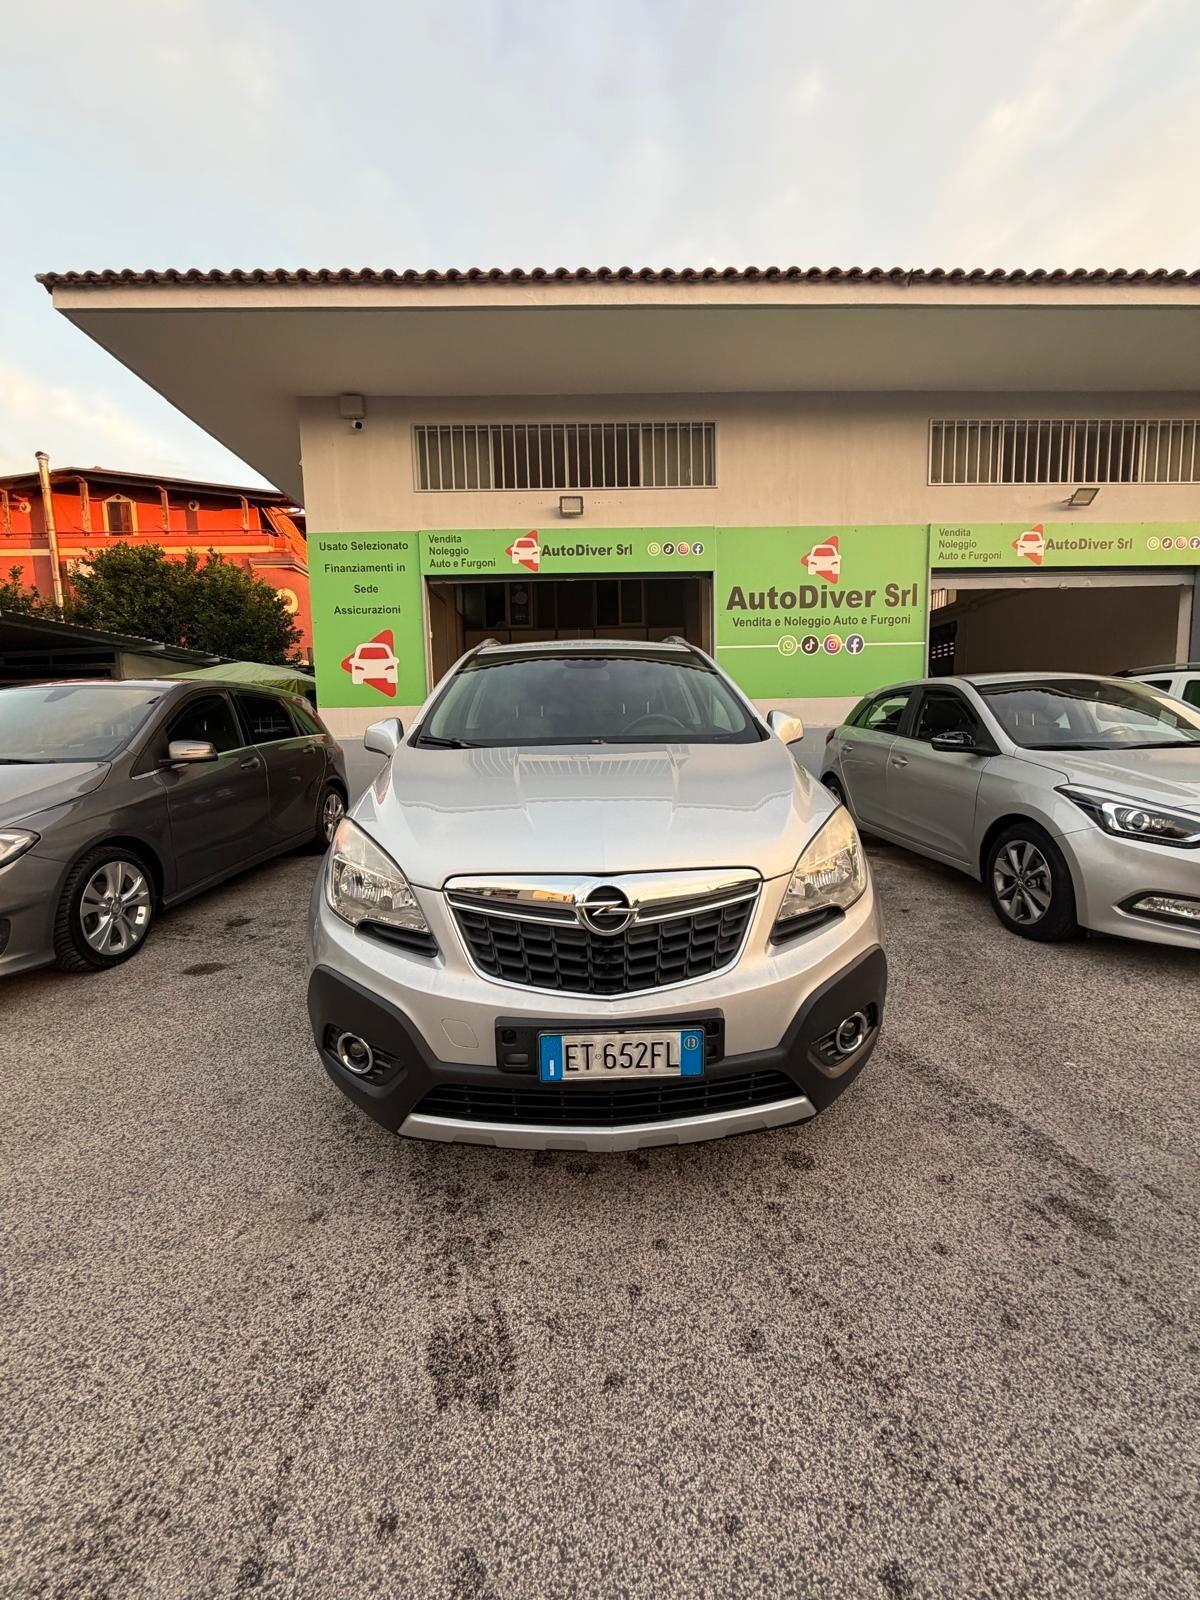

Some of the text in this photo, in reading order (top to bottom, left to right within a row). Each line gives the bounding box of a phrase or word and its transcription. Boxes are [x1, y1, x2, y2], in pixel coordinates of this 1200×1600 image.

[939, 528, 971, 537] Vendita
[428, 534, 462, 543] Vendita
[1046, 537, 1133, 551] AutoDiver Srl
[319, 541, 409, 551] Usato Selezionato
[542, 543, 633, 557] AutoDiver Srl
[939, 539, 977, 550] Noleggio
[429, 546, 469, 557] Noleggio
[938, 551, 959, 561] Auto
[969, 551, 1002, 561] Furgoni
[324, 563, 406, 573] Finanziamenti in
[429, 558, 496, 570] Auto e Furgoni
[354, 584, 379, 594] Sede
[726, 583, 917, 611] AutoDiver Srl
[334, 605, 401, 615] Assicurazioni
[732, 614, 911, 629] Vendita e Noleggio Auto e Furgoni
[565, 1041, 679, 1071] ET 652FL
